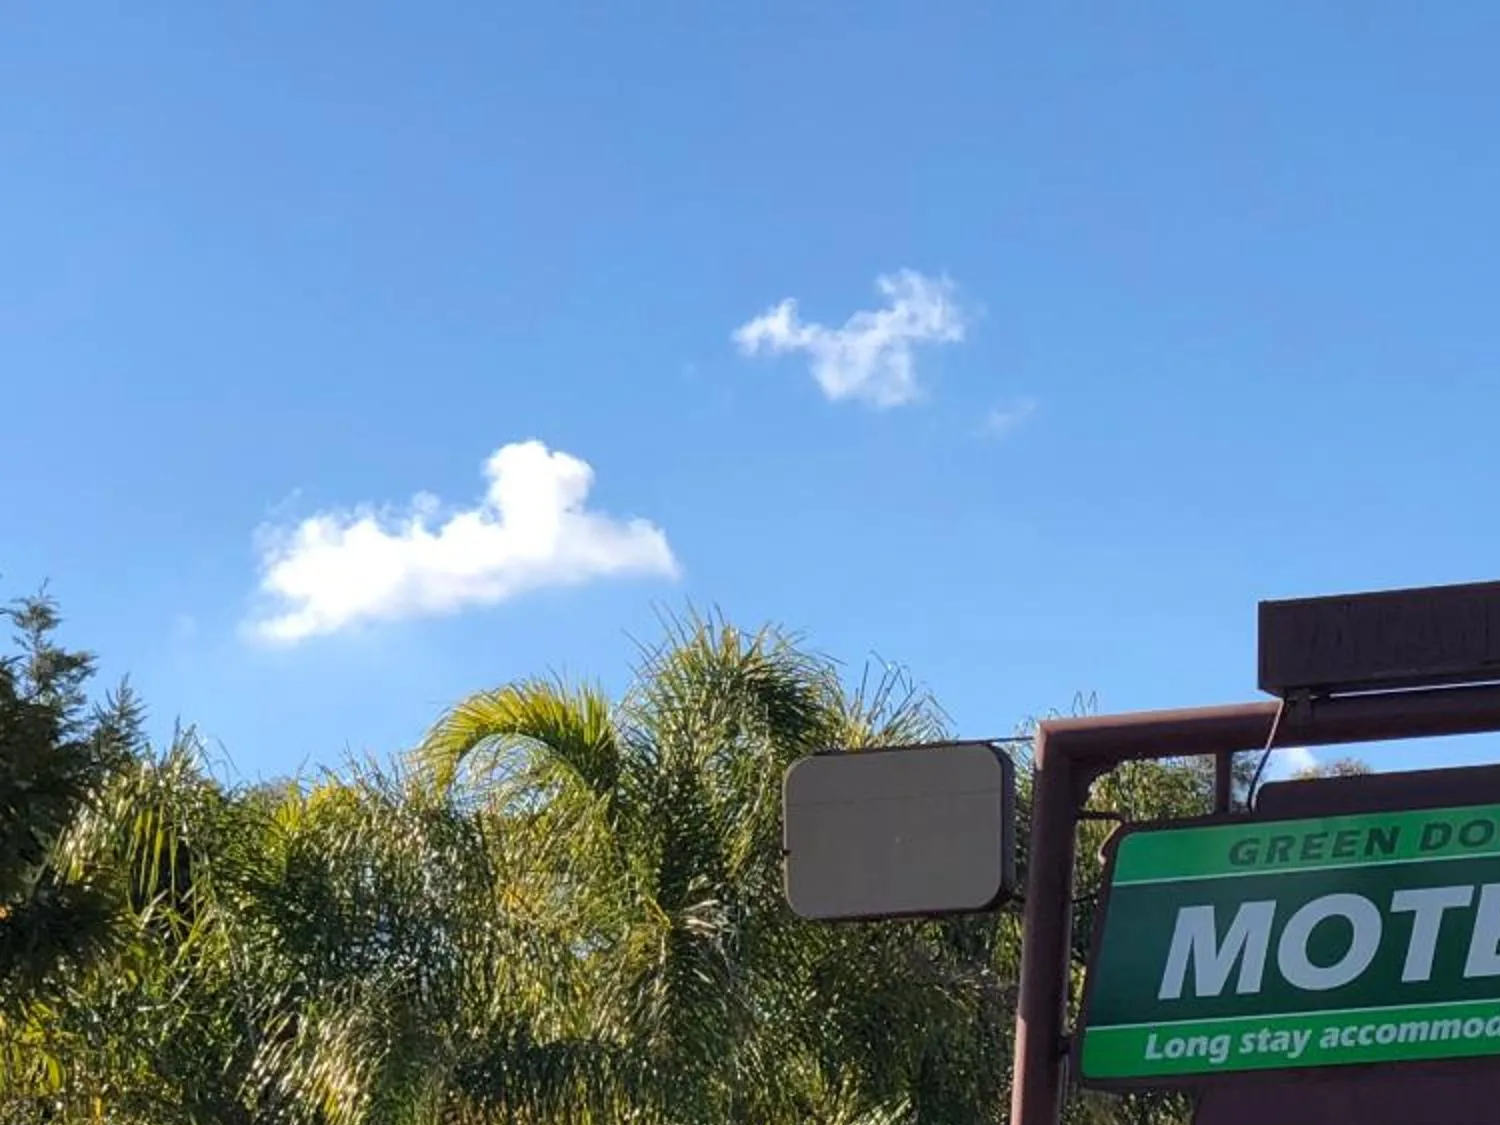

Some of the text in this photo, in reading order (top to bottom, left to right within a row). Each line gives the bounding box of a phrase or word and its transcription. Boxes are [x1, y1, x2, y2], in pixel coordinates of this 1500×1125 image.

[1229, 825, 1401, 866] GREEN
[1144, 1032, 1229, 1063] Long
[1239, 1026, 1310, 1058] stay
